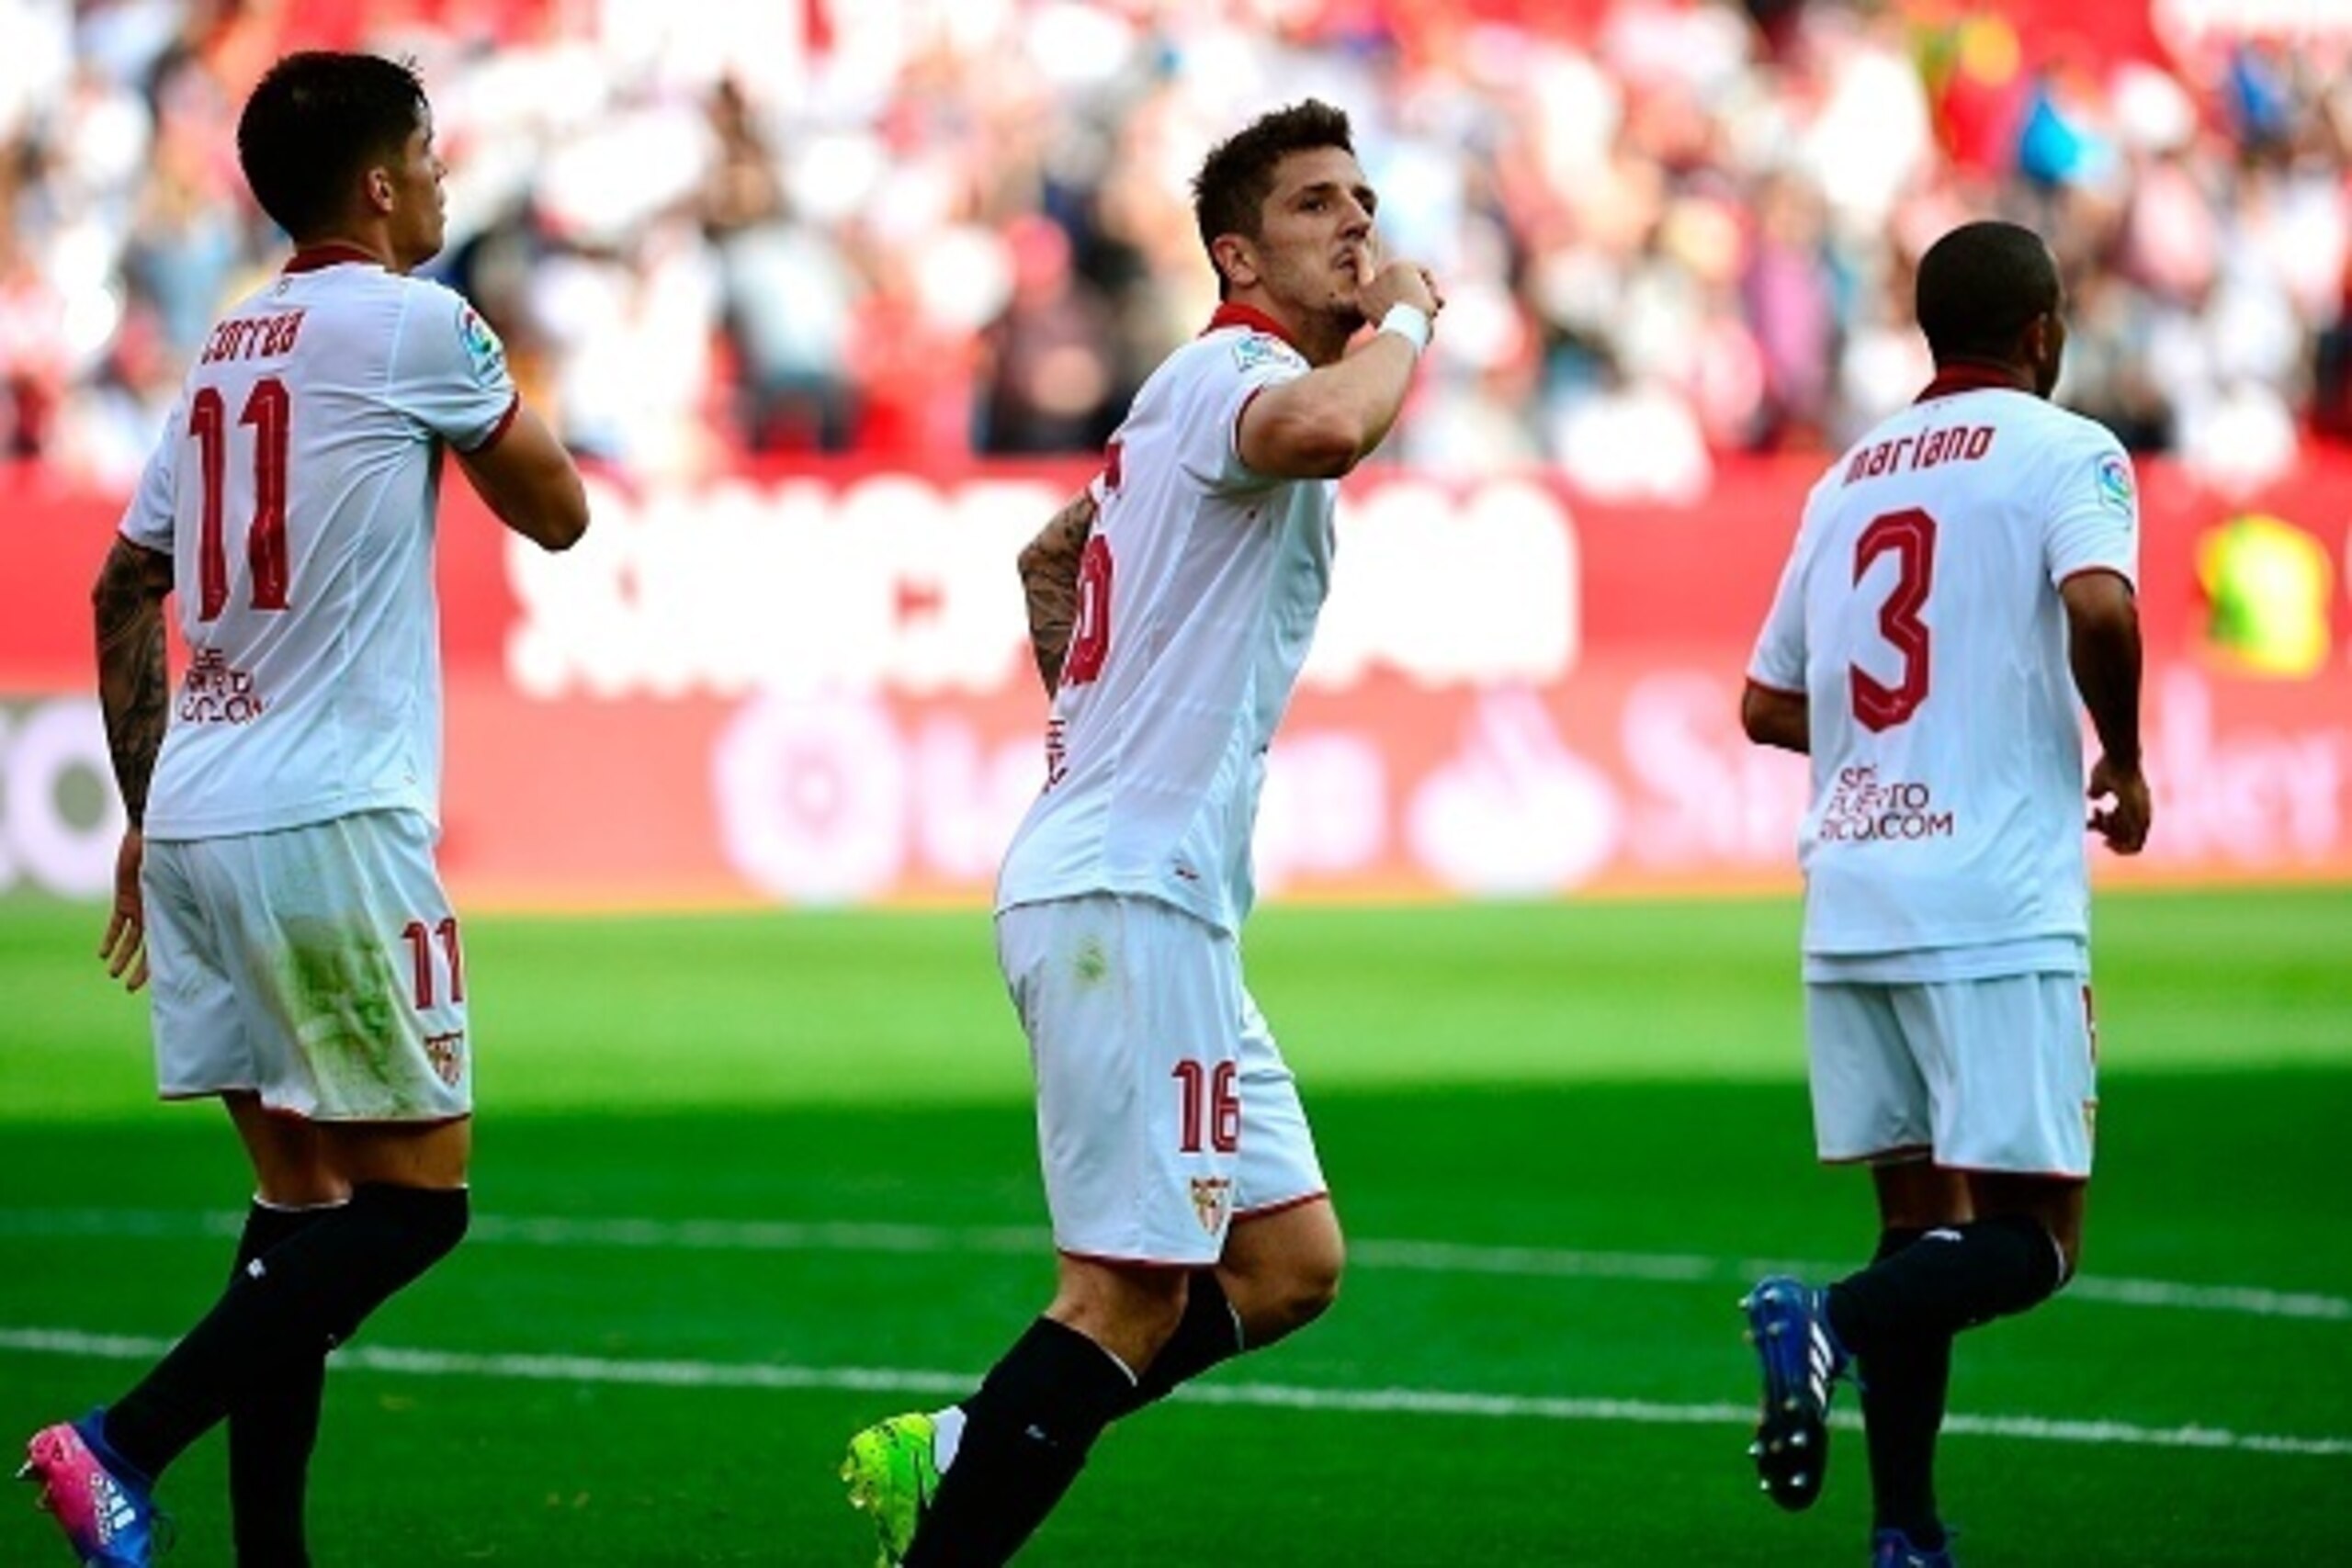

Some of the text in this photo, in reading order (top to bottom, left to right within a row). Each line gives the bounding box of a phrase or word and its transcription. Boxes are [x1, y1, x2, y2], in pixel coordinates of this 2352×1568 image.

[190, 378, 289, 622] 11
[1841, 426, 1996, 488] mariano
[1849, 507, 1937, 734] 3
[401, 917, 463, 1010] 11
[1171, 1060, 1239, 1153] 16
